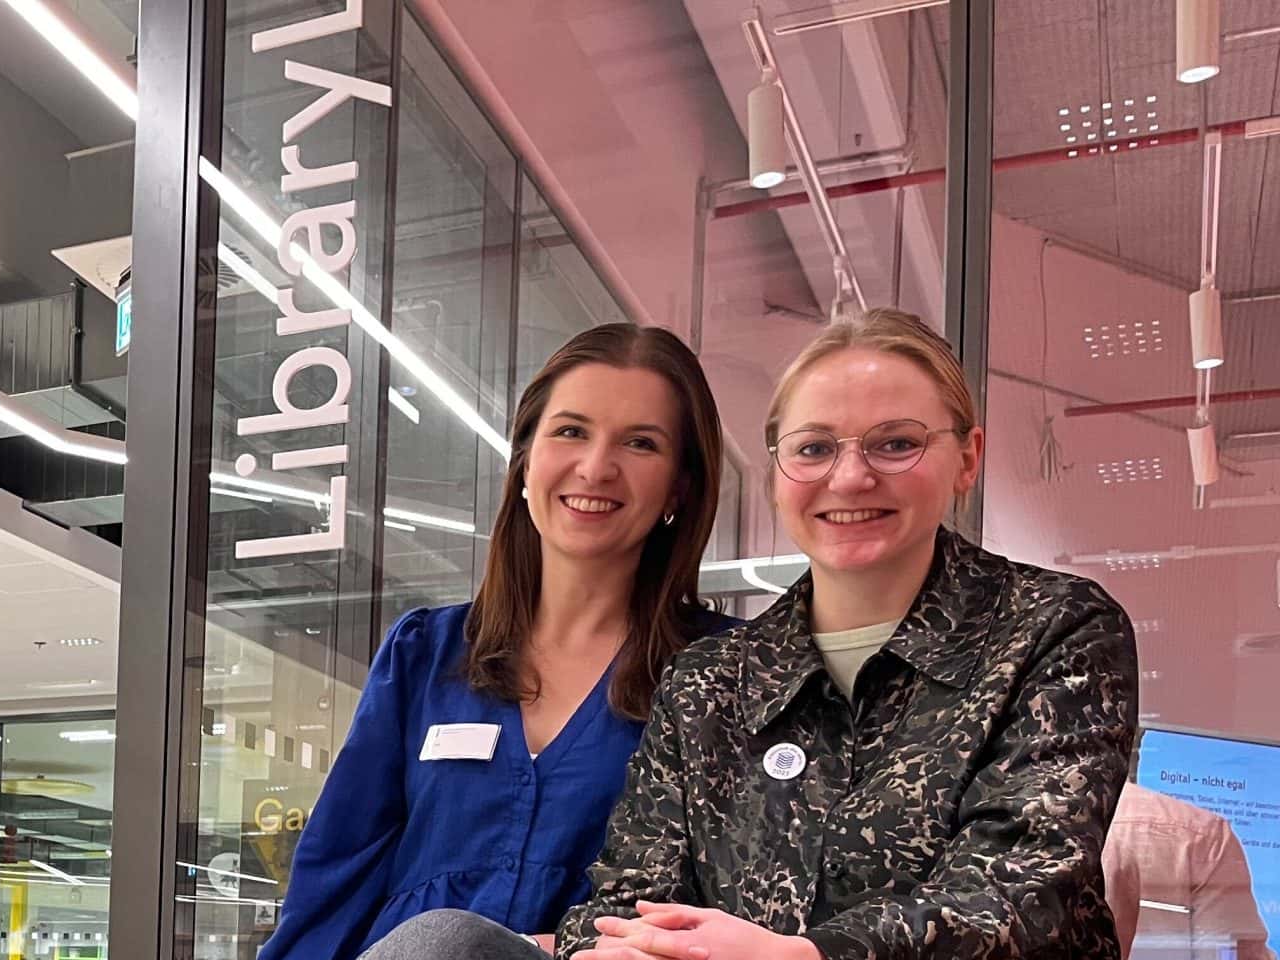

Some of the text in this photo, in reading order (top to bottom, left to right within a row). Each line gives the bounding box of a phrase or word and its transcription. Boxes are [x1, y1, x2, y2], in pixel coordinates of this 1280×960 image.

[234, 59, 393, 560] Library
[1160, 770, 1191, 784] Digital
[1201, 775, 1225, 788] nicht
[1226, 778, 1246, 791] egal
[254, 797, 313, 832] Ga
